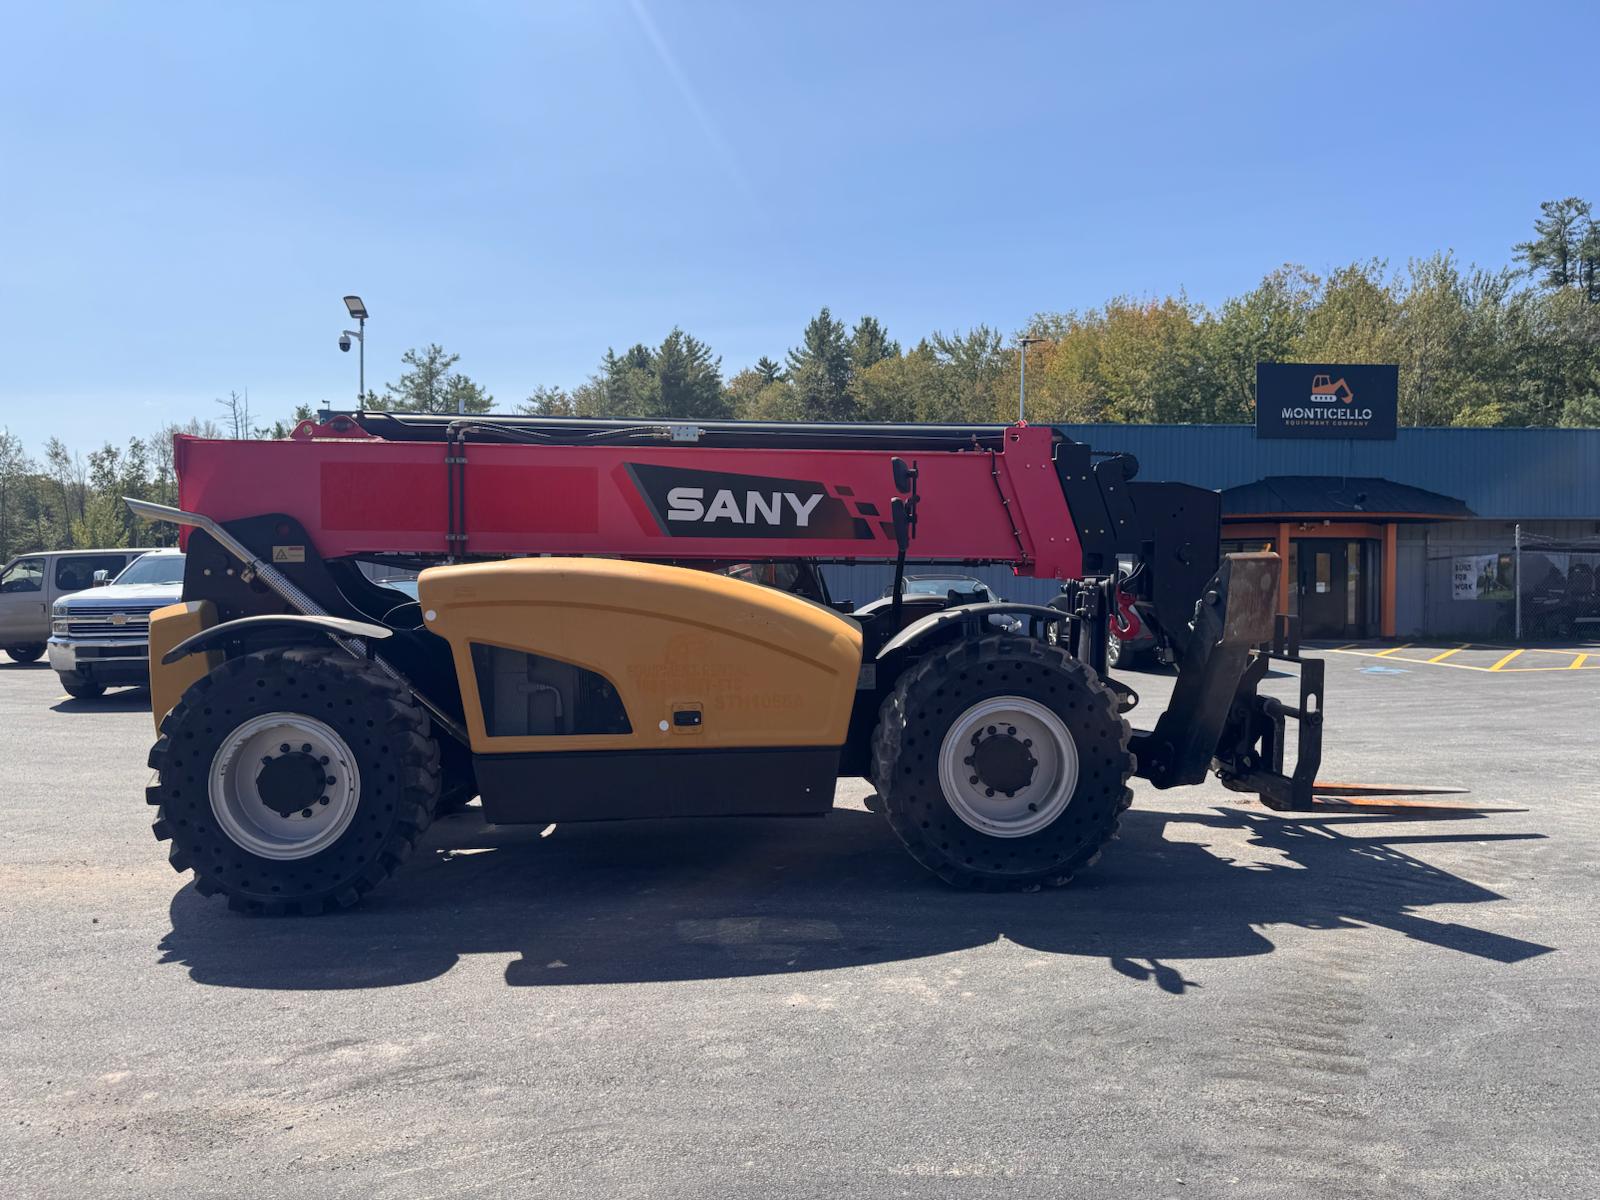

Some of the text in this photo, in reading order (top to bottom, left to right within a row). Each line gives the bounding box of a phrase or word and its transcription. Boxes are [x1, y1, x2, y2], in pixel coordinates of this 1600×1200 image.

[1281, 407, 1372, 420] MONTICELLO
[667, 486, 824, 527] SANY
[1455, 583, 1473, 591] WORK
